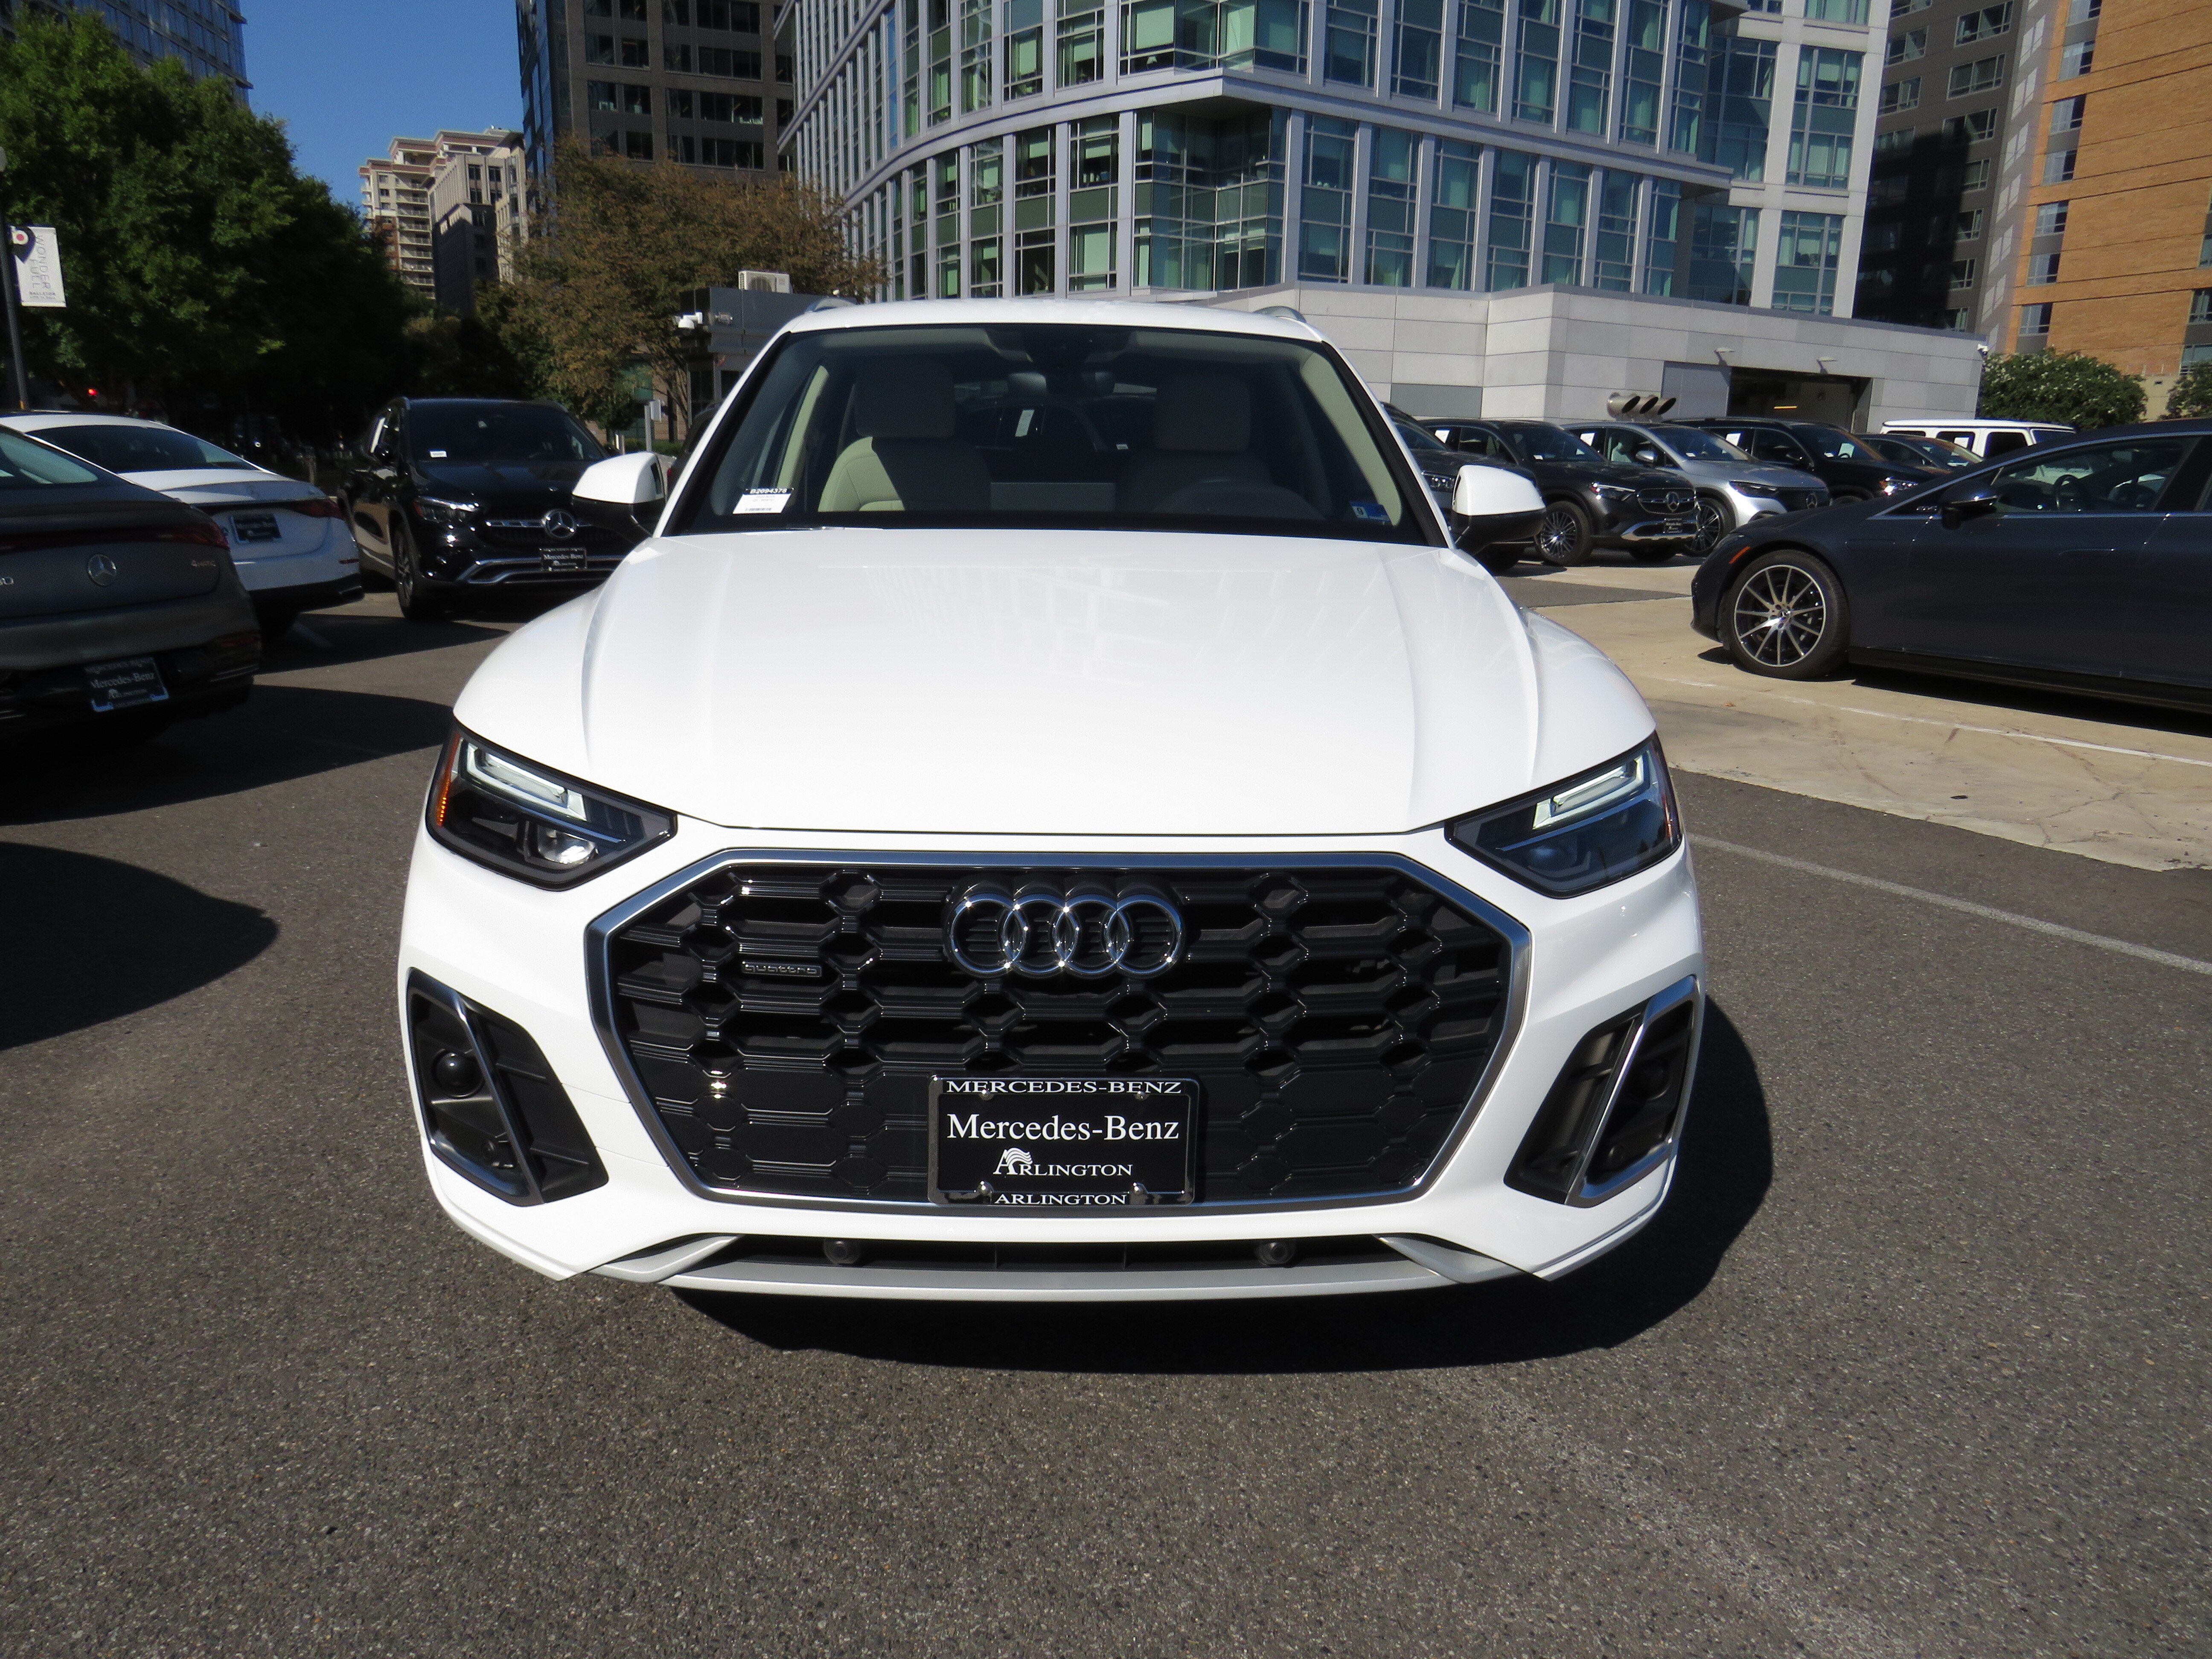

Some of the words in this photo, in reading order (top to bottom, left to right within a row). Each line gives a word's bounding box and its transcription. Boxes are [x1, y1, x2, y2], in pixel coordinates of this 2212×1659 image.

[35, 235, 51, 289] WONDER
[29, 259, 40, 288] FULL
[1357, 507, 1364, 515] 9
[745, 964, 817, 974] quattro
[946, 1080, 1182, 1094] MERCEDES-BENZ
[946, 1114, 1179, 1141] Mercedes-Benz
[992, 1147, 1133, 1176] ARLINGTON
[994, 1193, 1127, 1205] ARLINGTON
